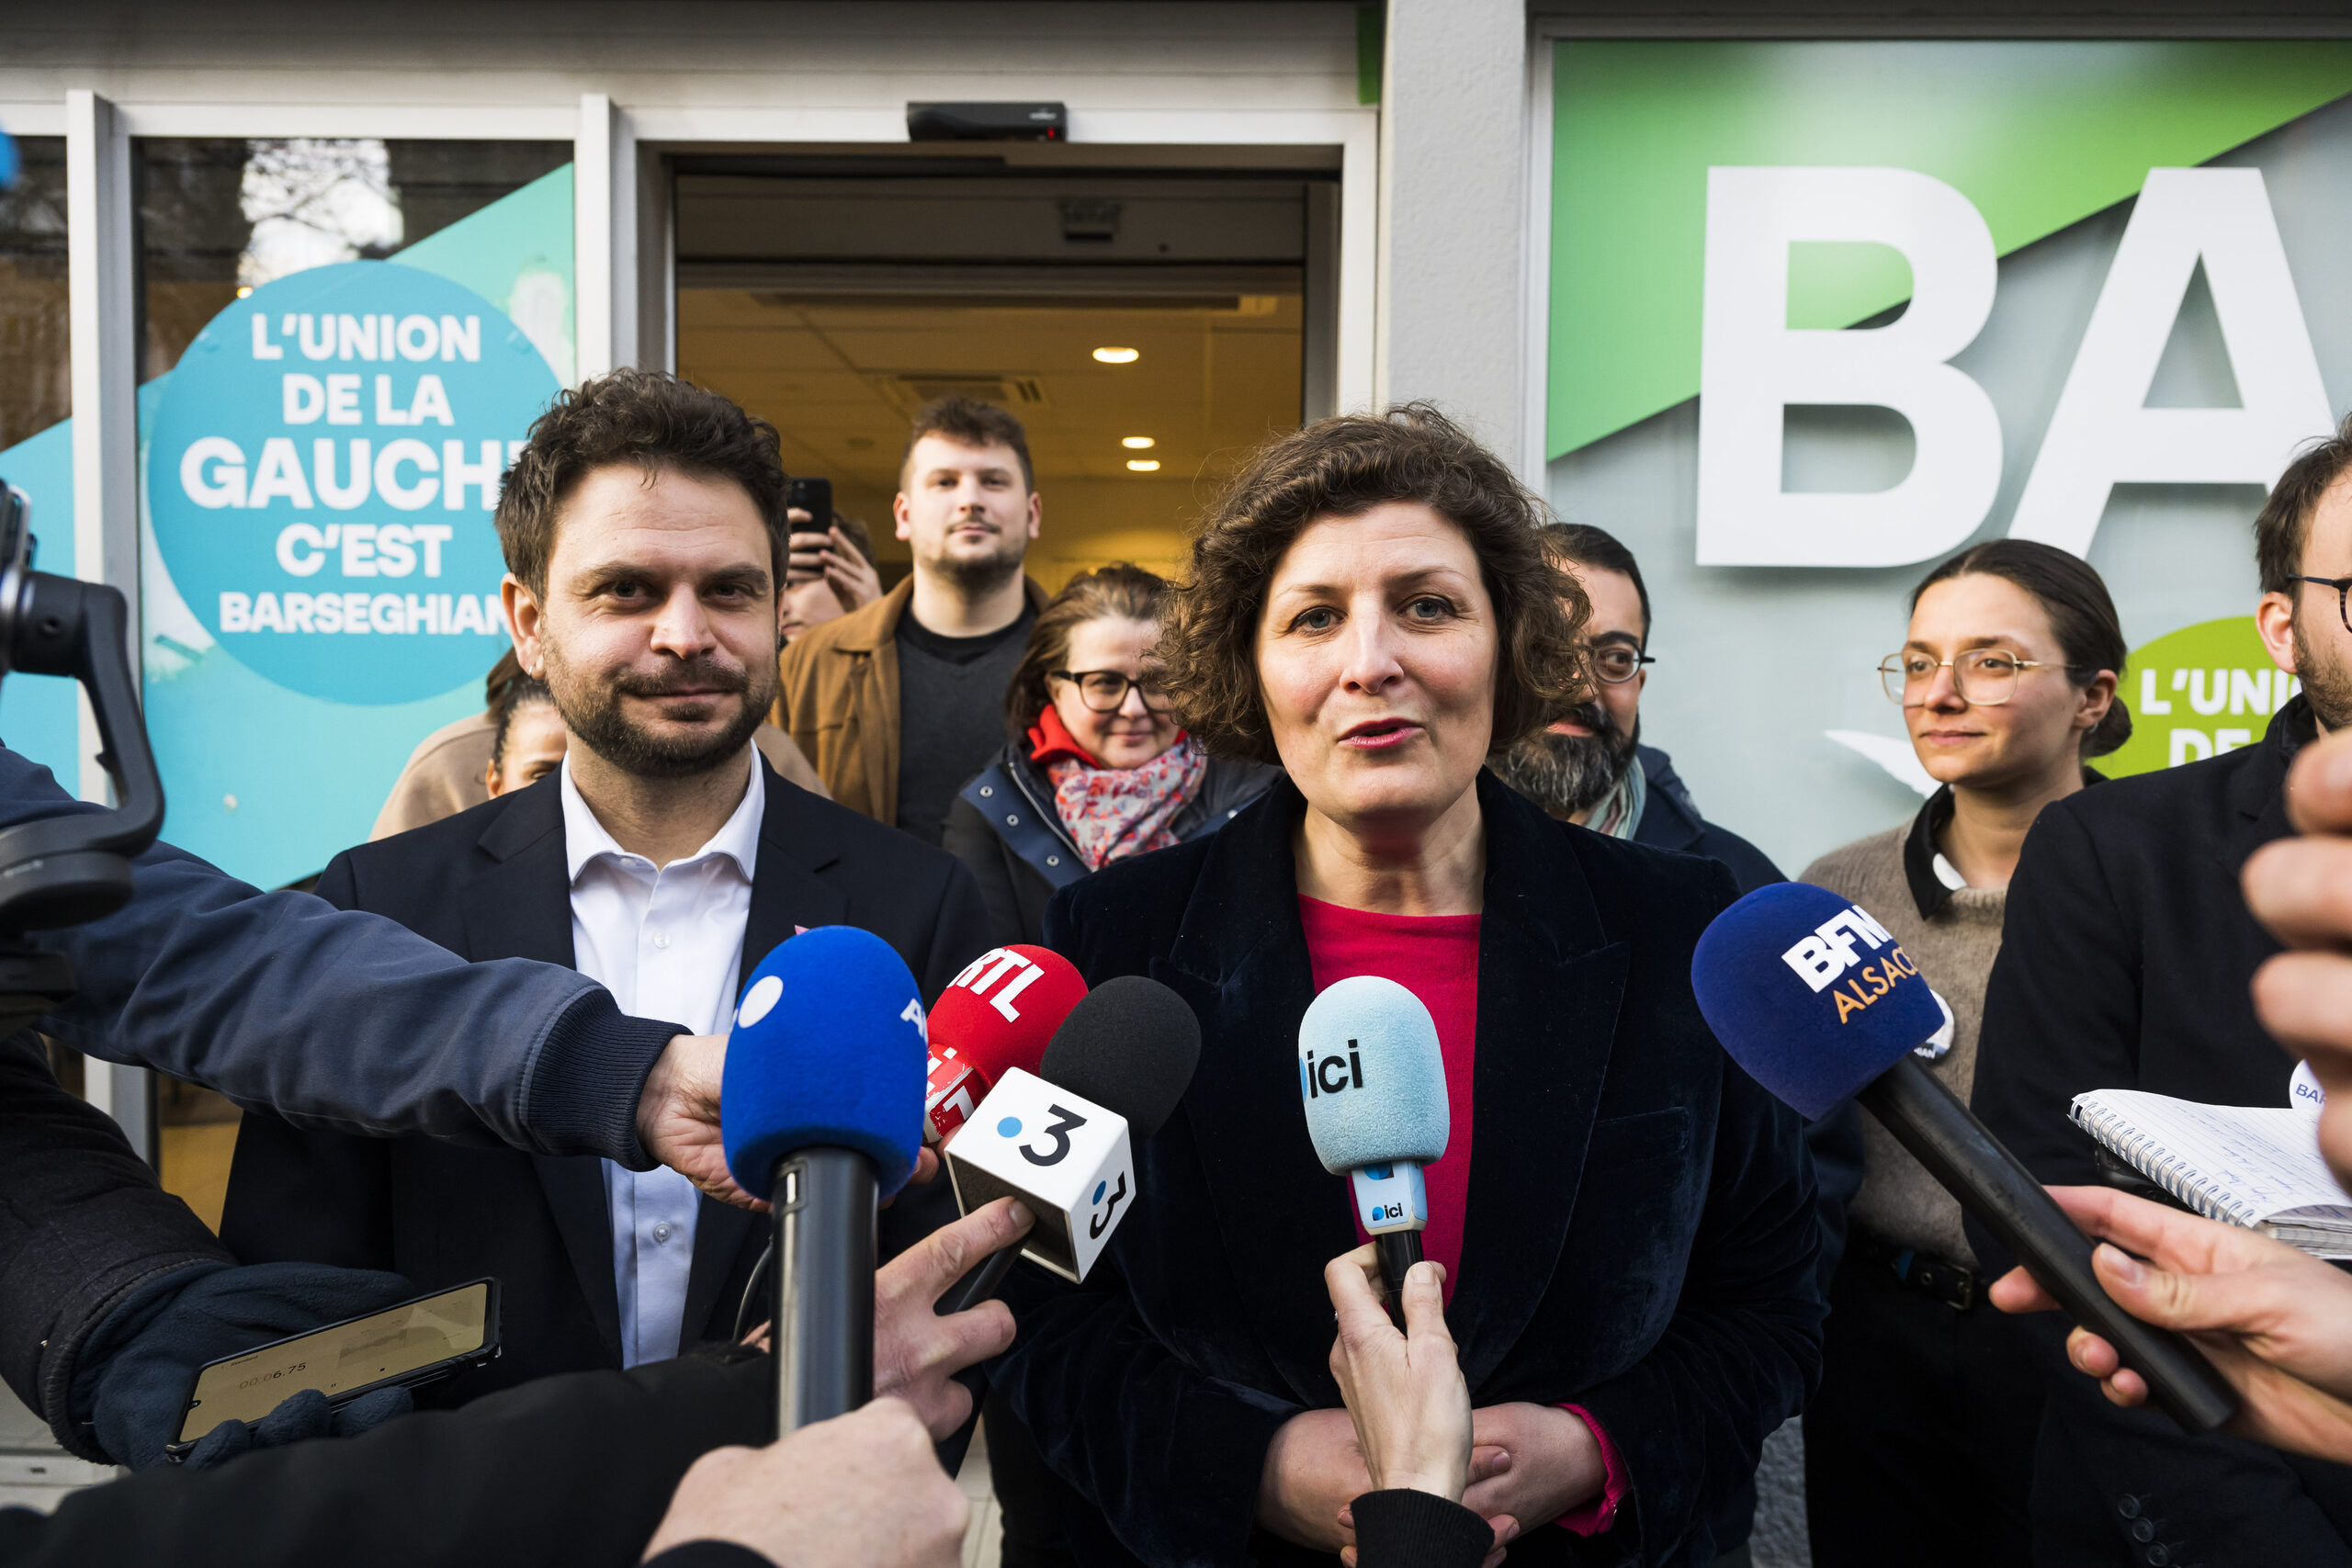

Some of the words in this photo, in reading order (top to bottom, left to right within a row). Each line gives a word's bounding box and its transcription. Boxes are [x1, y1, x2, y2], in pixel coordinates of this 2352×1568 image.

[251, 313, 481, 363] L'UNION
[1695, 165, 2336, 568] BA
[283, 374, 363, 425] DE
[375, 375, 455, 426] LA
[276, 523, 452, 579] C'EST
[220, 592, 511, 636] BARSEGHIAN
[2140, 668, 2301, 716] L'UNI
[1781, 904, 1894, 994] BFM
[946, 947, 1046, 1023] RTL
[1833, 946, 1919, 1024] ALSAC
[1307, 1038, 1363, 1099] ici
[1019, 1104, 1088, 1167] 3
[1090, 1170, 1127, 1240] 3
[1384, 1202, 1404, 1219] ici
